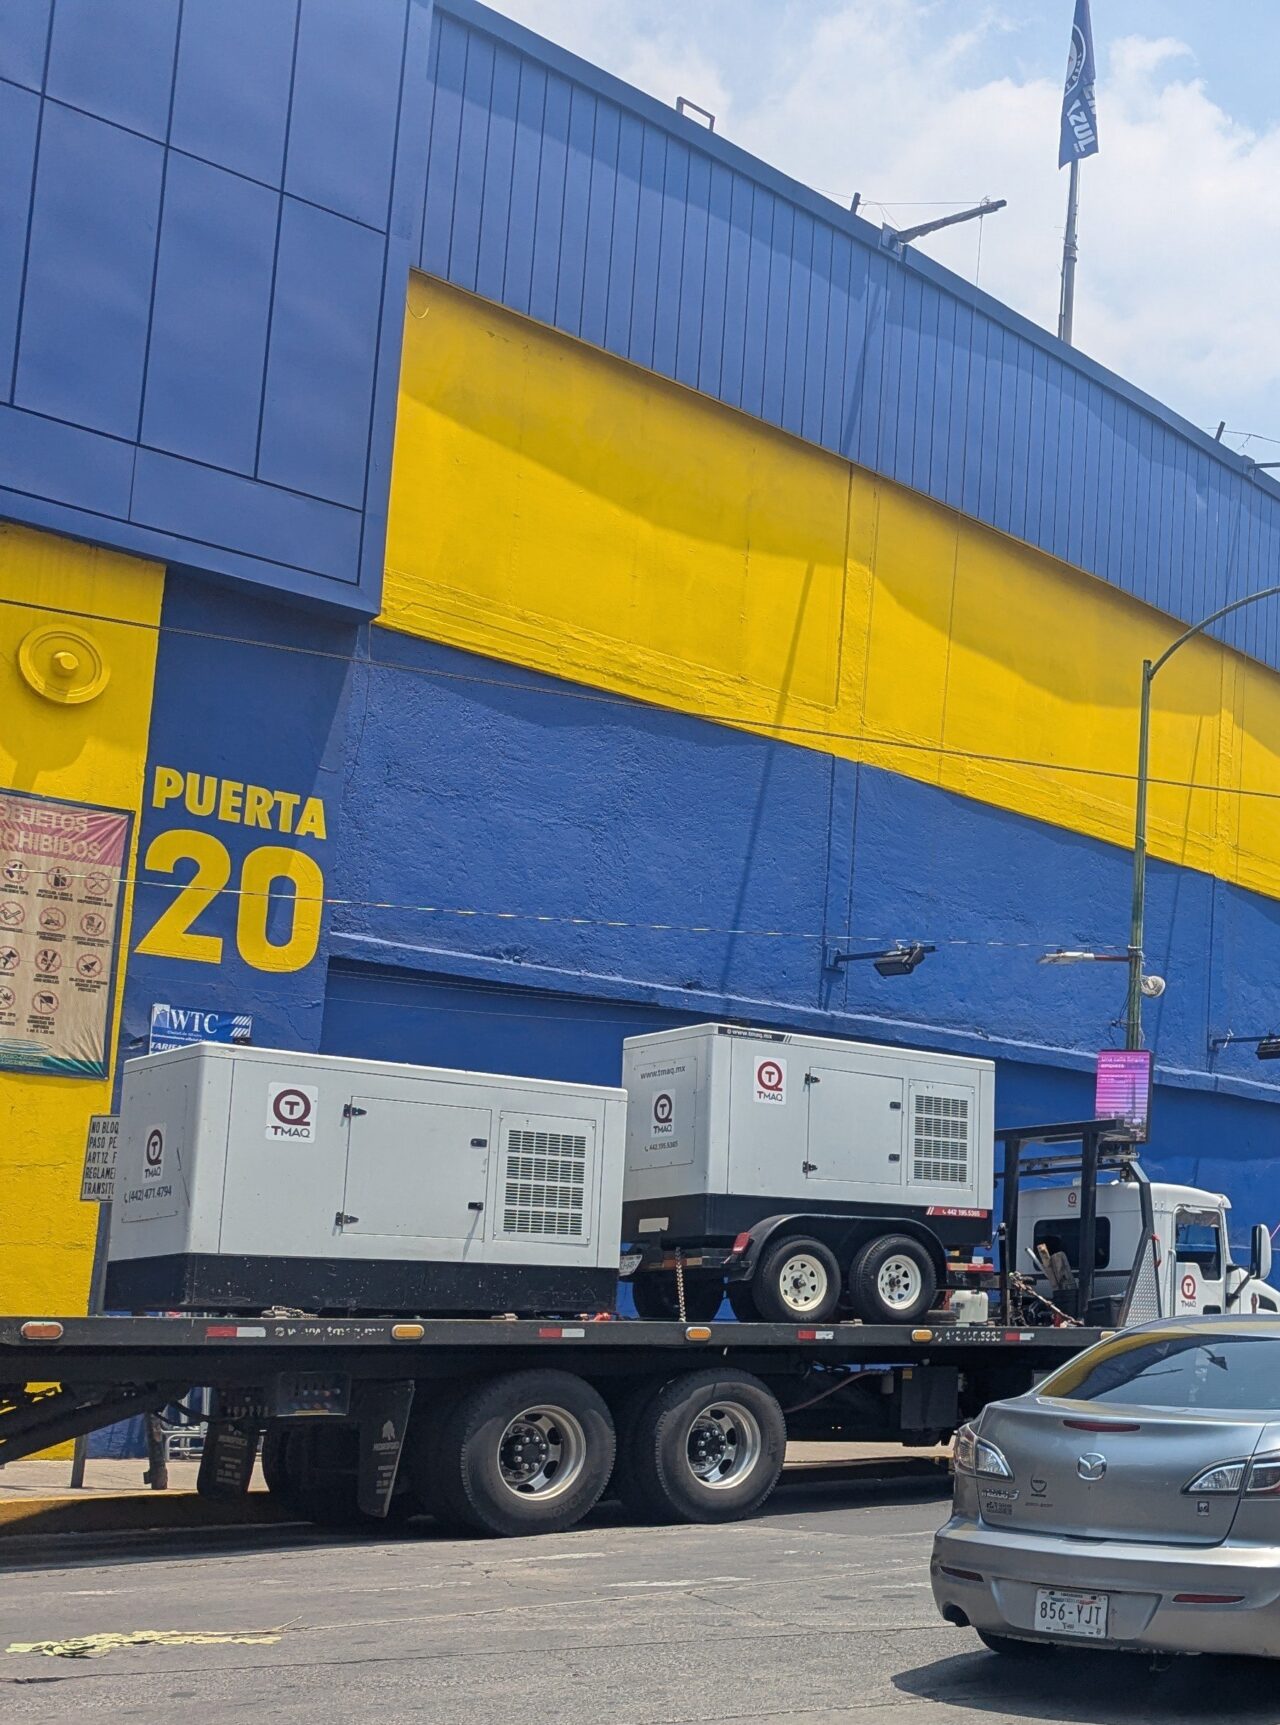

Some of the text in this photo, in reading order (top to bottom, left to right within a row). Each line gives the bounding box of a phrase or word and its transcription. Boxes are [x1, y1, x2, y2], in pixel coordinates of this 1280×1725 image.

[152, 766, 326, 840] PUERTA
[0, 827, 101, 860] OHIBIDOS
[134, 829, 324, 973] 20
[171, 1008, 219, 1034] WTC
[640, 1065, 686, 1080] www.tmaq.mx
[757, 1091, 783, 1102] TMAQ
[91, 1121, 120, 1134] NO BLOQ
[271, 1125, 311, 1138] TMAQ
[653, 1124, 672, 1134] TMAQ
[88, 1136, 118, 1149] PASO PE
[85, 1166, 116, 1180] REGLAME
[145, 1167, 161, 1179] TMAQ
[1040, 1601, 1102, 1625] 856-YJT
